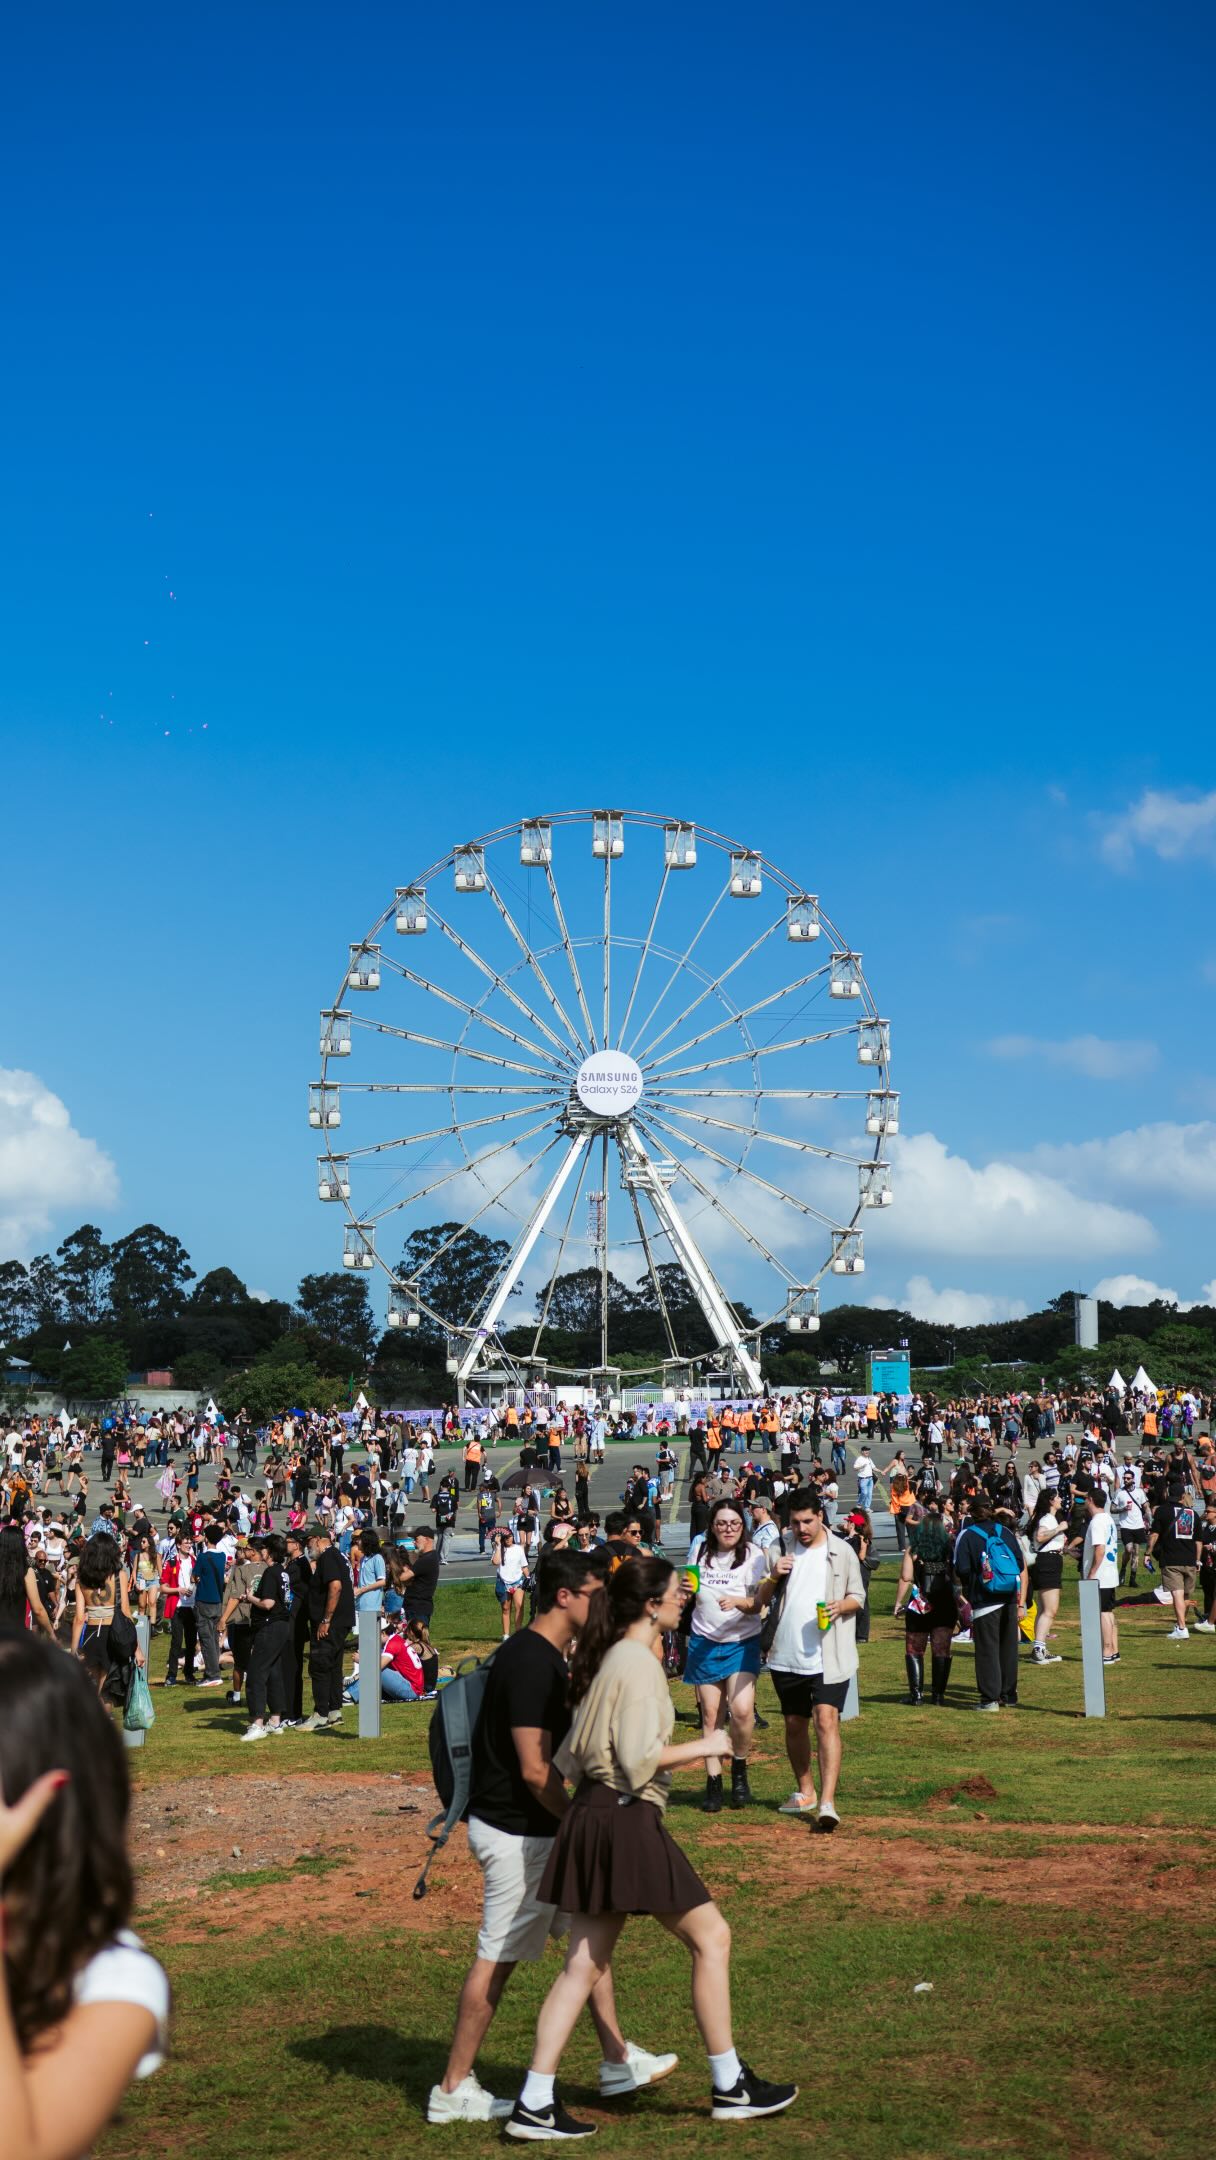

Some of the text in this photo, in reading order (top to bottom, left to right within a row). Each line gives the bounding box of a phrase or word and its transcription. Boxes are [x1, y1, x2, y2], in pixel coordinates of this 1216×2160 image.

[581, 1072, 638, 1082] SAMSUNG
[581, 1085, 638, 1096] Galaxy S26
